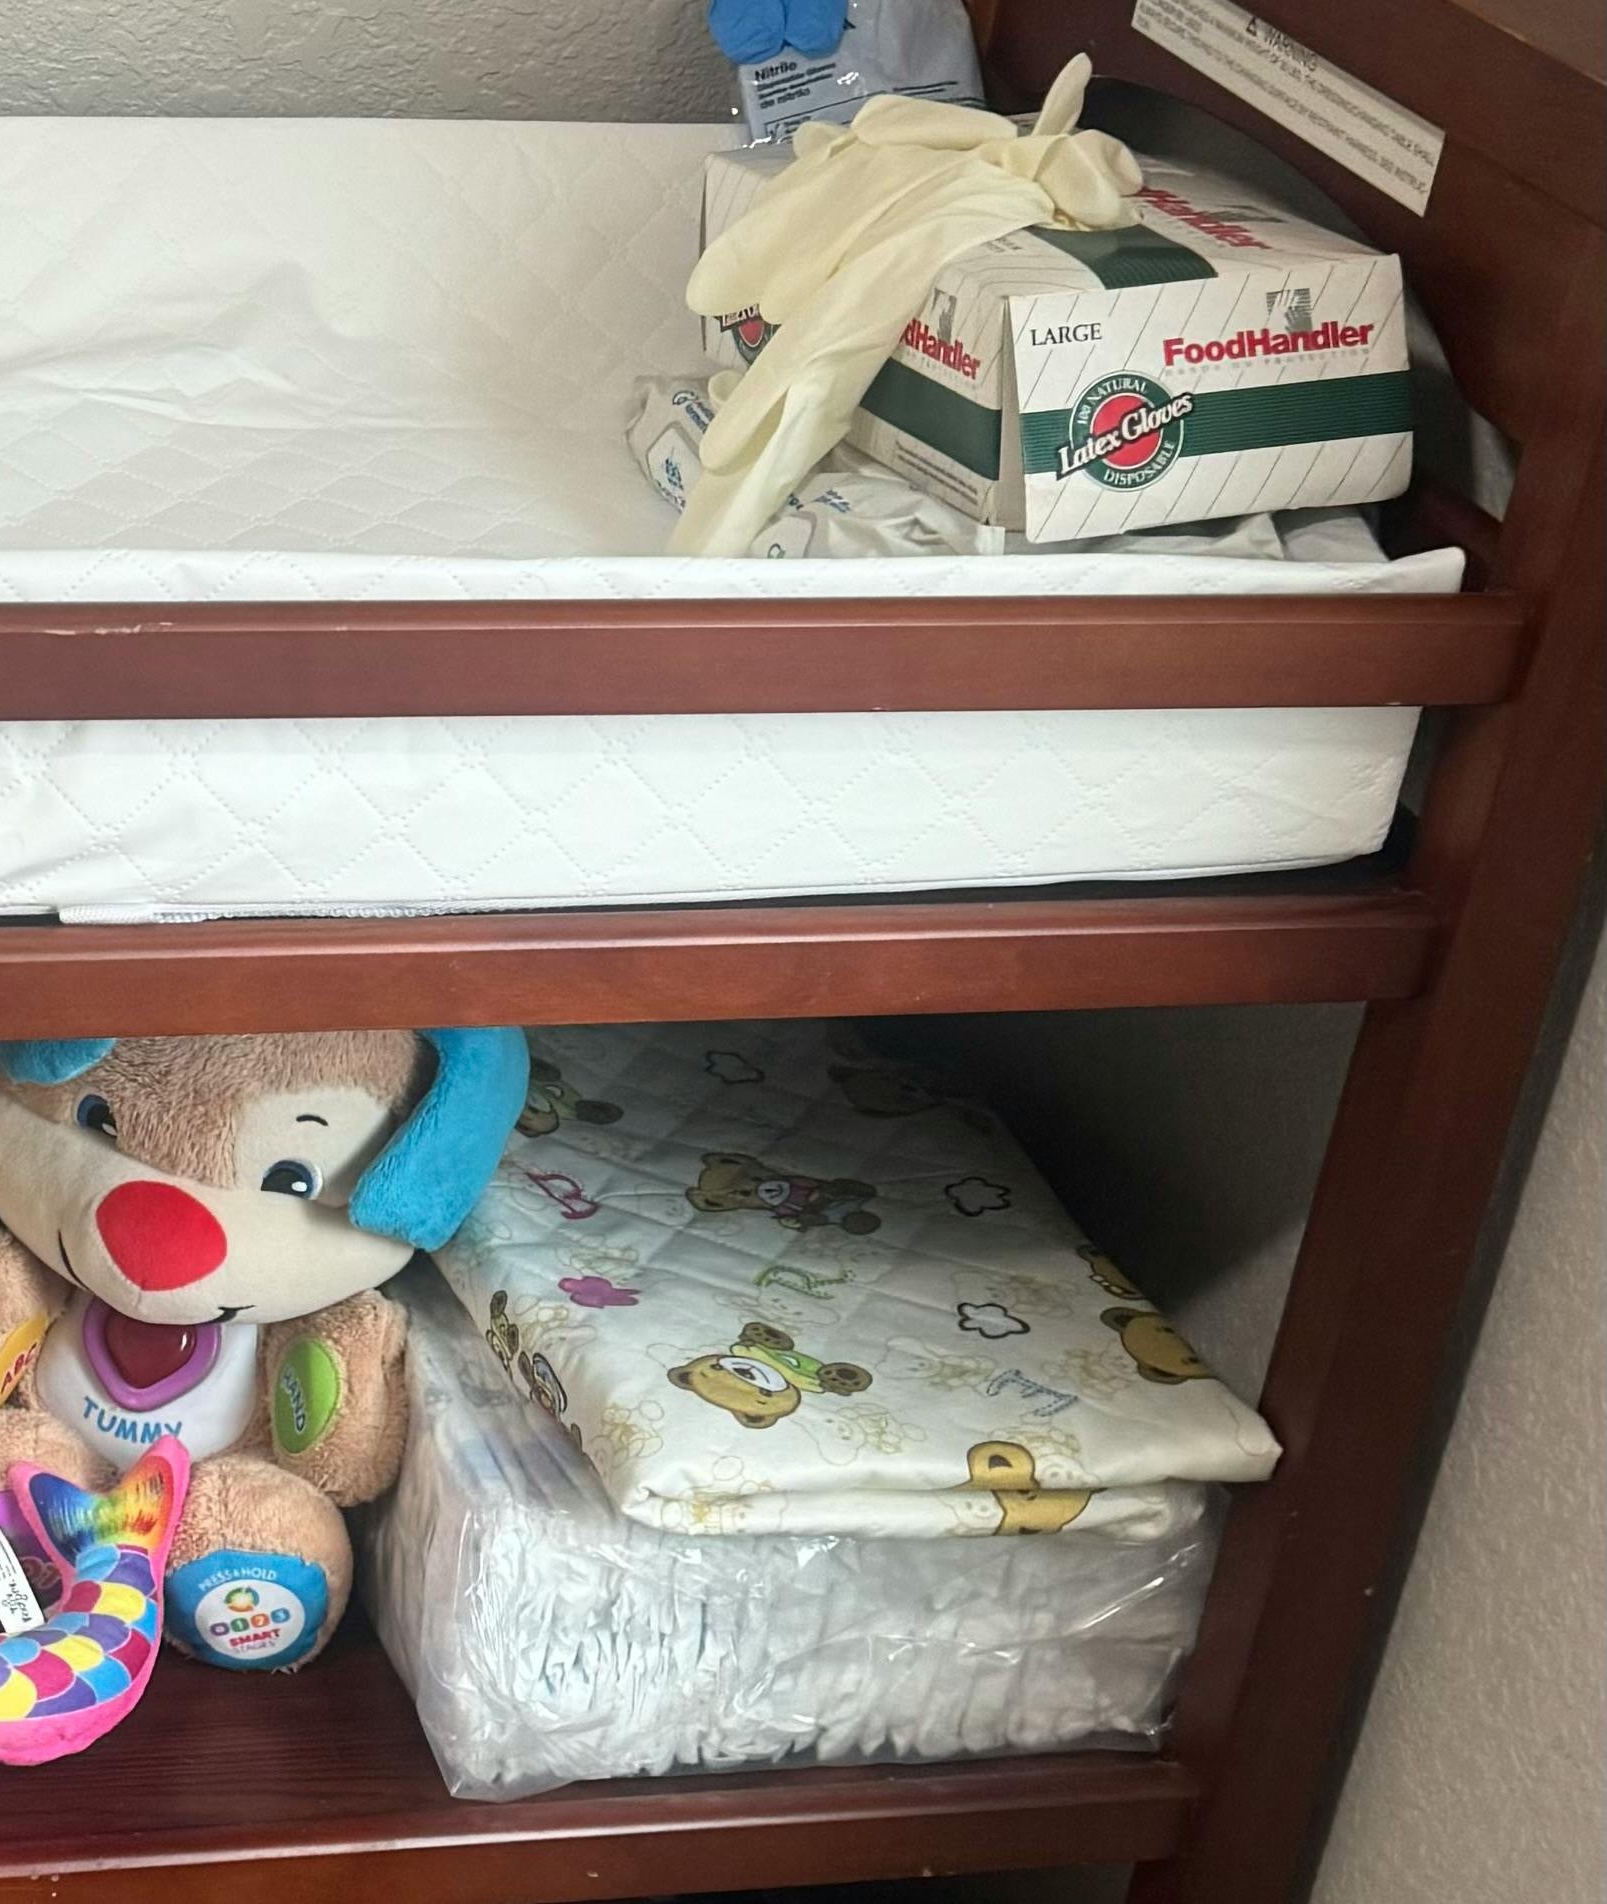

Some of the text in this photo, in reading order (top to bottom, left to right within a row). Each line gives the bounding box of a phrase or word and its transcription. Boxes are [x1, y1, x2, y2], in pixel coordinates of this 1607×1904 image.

[900, 318, 981, 381] dHandler
[1030, 322, 1102, 346] LARGE
[1162, 320, 1375, 367] FoodHandler
[1086, 377, 1148, 404] NATURAL
[1057, 394, 1194, 474] Latex Gloves
[1103, 440, 1176, 486] DISPOSABLE
[83, 1395, 182, 1444] TUMMY
[281, 1367, 306, 1432] HAND
[198, 1570, 232, 1591] PRESS
[241, 1566, 277, 1581] HOLD
[229, 1629, 281, 1648] SMART
